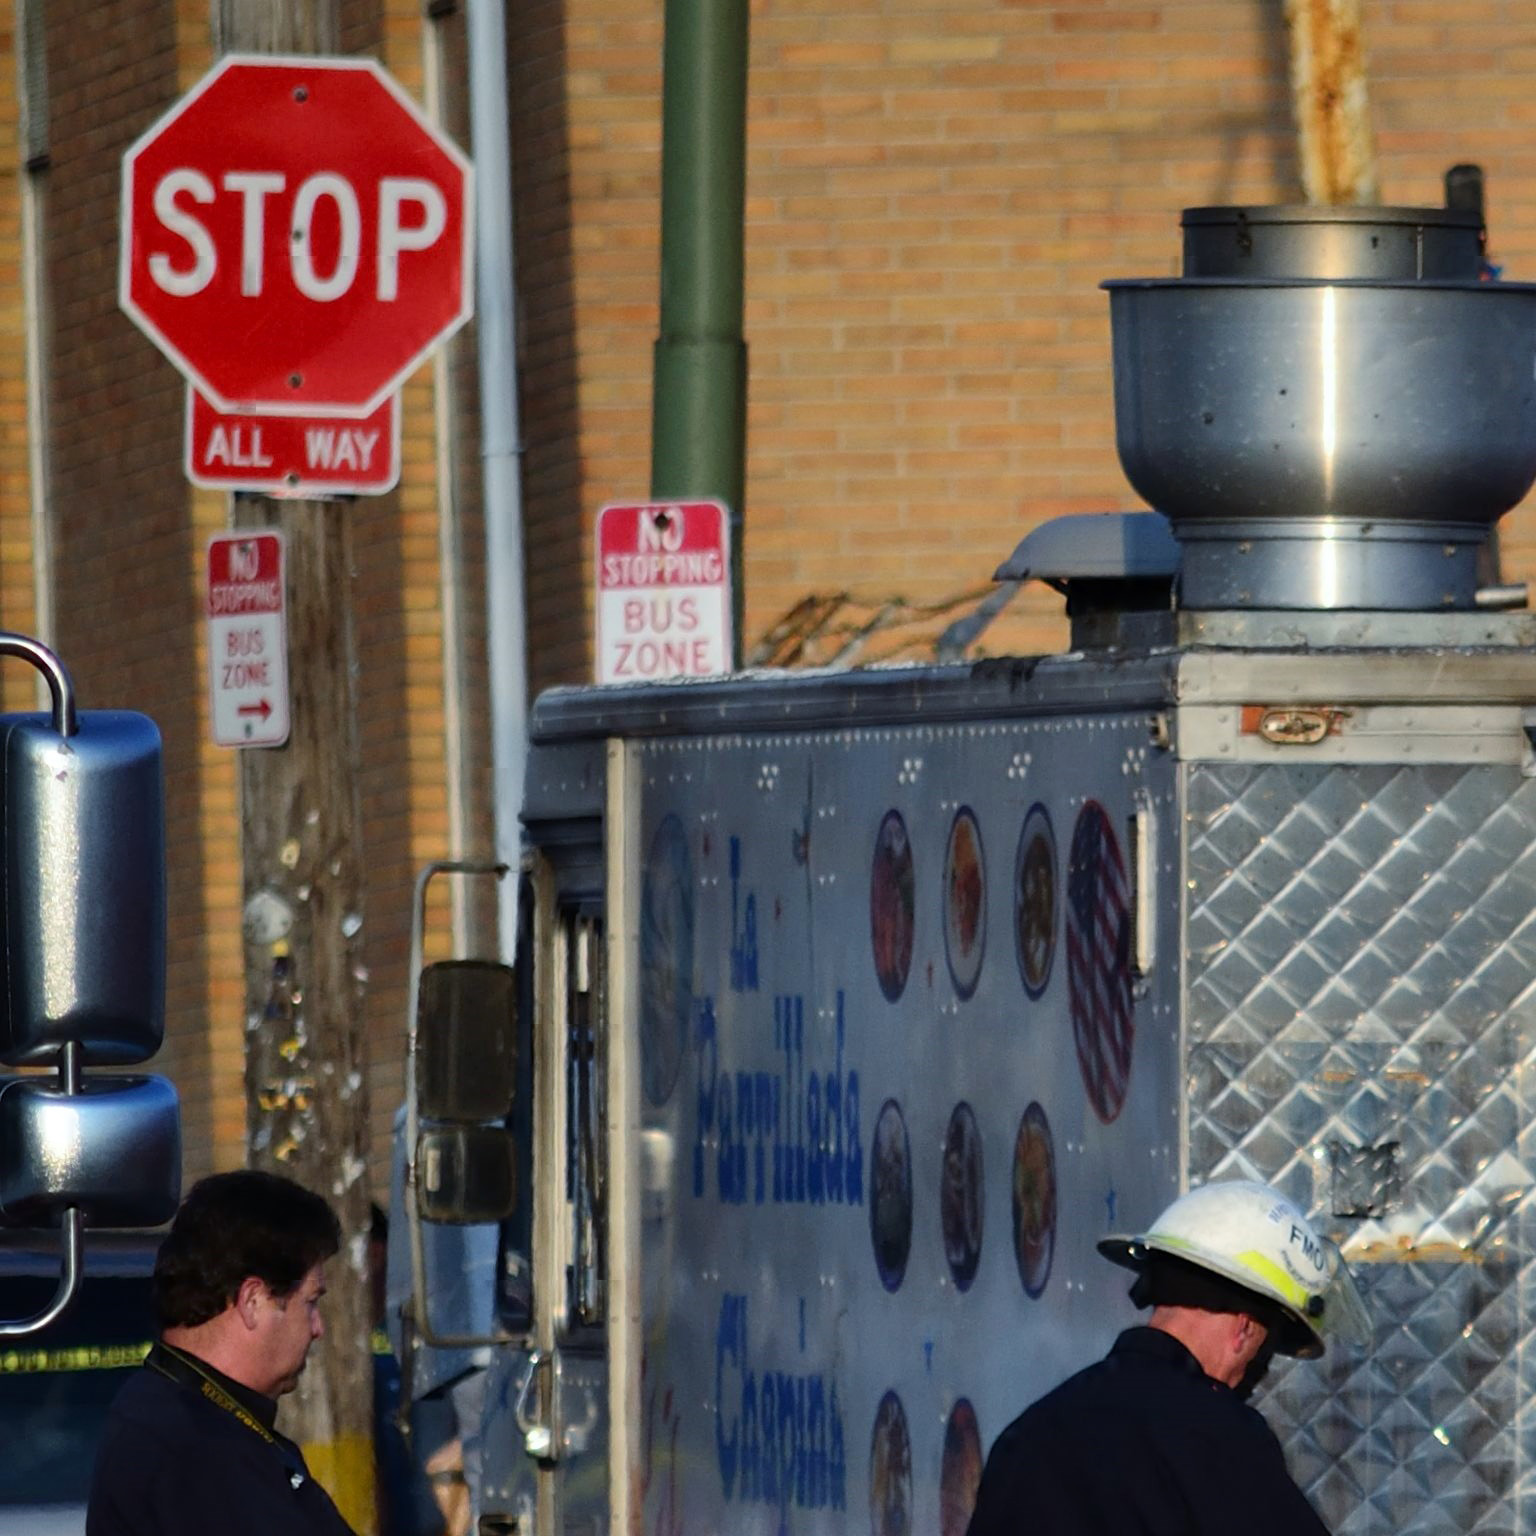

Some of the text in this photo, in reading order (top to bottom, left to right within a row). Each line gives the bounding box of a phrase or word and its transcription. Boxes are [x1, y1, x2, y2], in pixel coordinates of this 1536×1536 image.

[148, 168, 448, 303] STOP
[205, 426, 380, 471] ALL WAY
[638, 506, 685, 553] NO
[229, 539, 260, 582] NO
[604, 551, 723, 587] STOPPING
[623, 597, 699, 635] BUS
[227, 628, 265, 658] BUS
[612, 639, 712, 677] ZONE
[222, 661, 271, 690] ZONE
[1289, 1224, 1326, 1273] FMO
